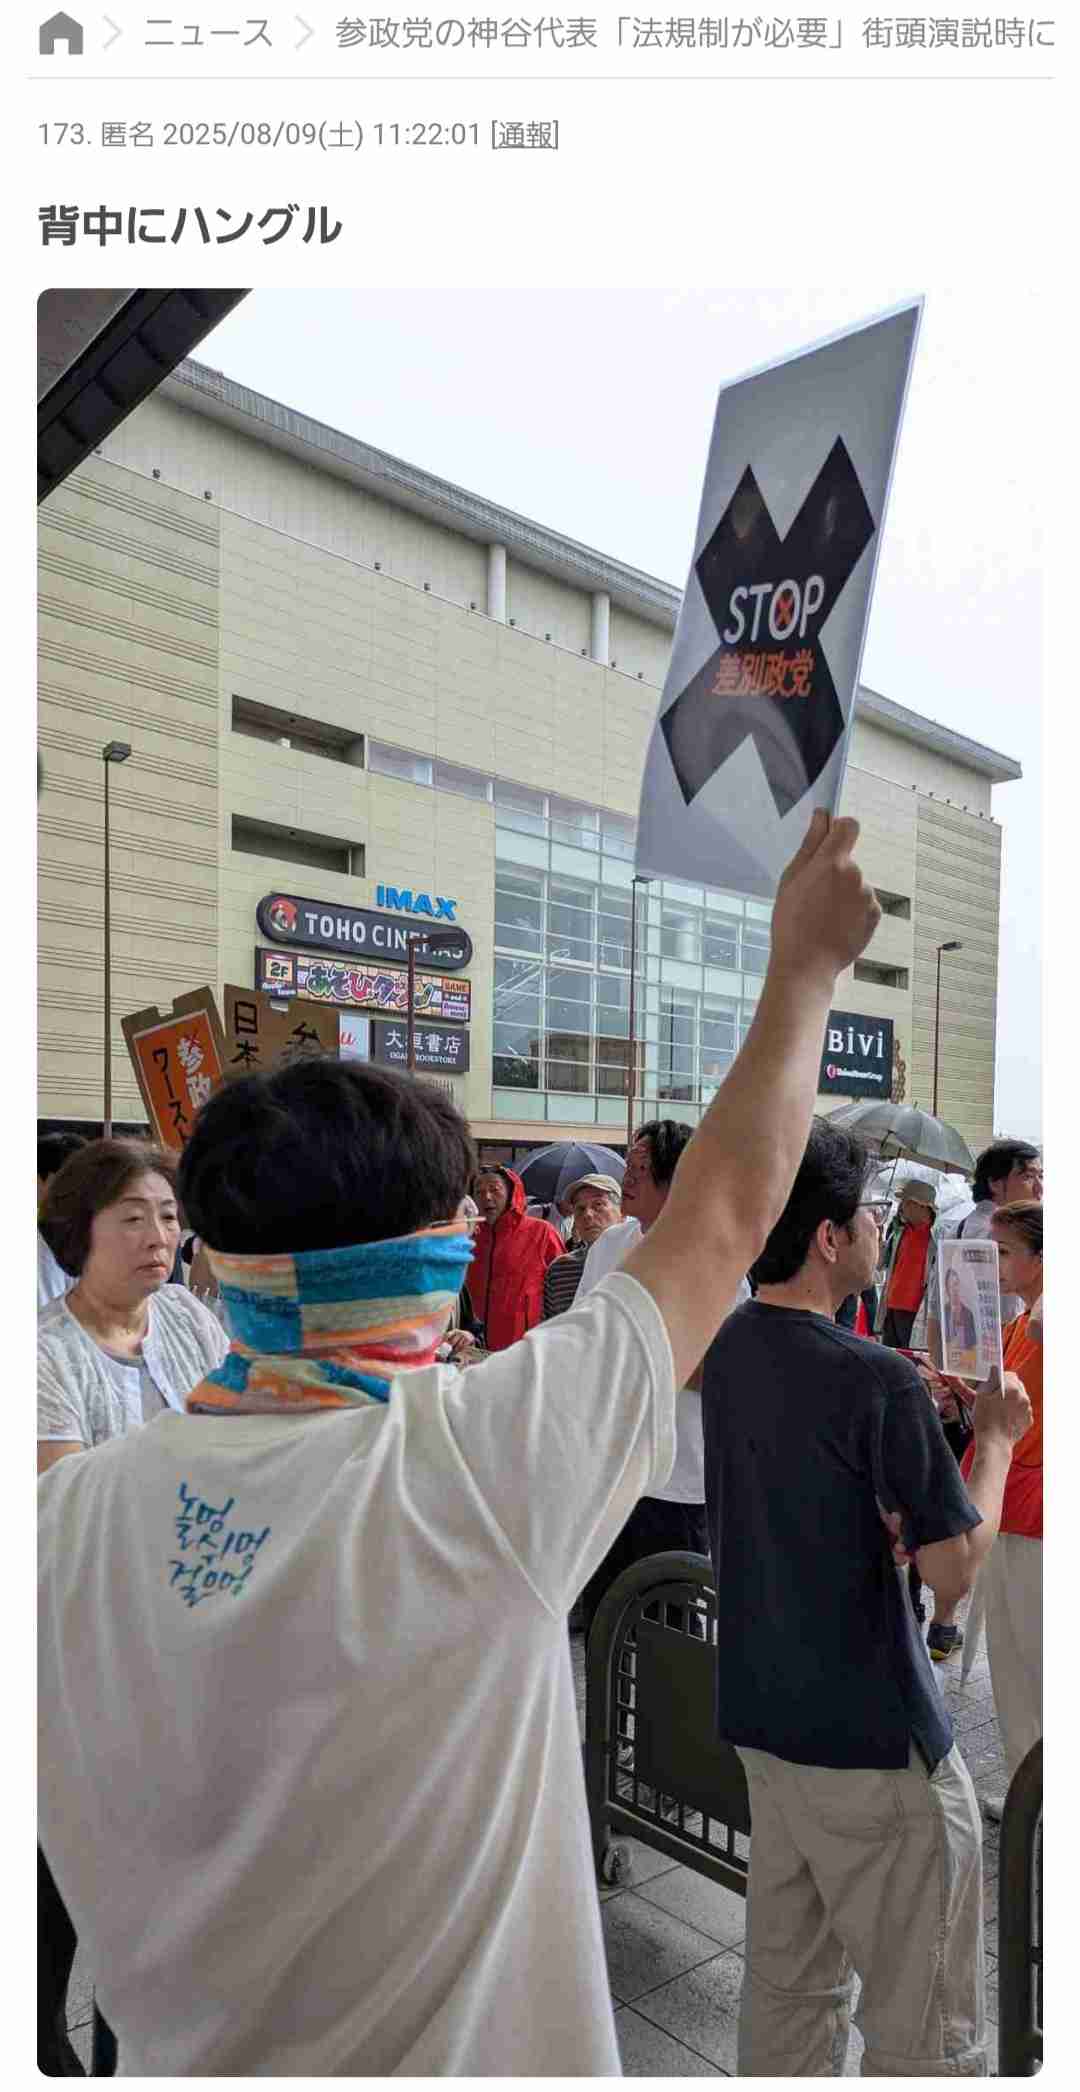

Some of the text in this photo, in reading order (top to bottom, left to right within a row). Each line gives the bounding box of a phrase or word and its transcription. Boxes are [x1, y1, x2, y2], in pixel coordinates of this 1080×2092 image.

[724, 573, 825, 645] STOP
[711, 648, 815, 698] 差別政党
[375, 885, 457, 921] IMAX
[304, 912, 366, 944] TOHO
[270, 961, 289, 977] 2F
[230, 1000, 263, 1070] 日本
